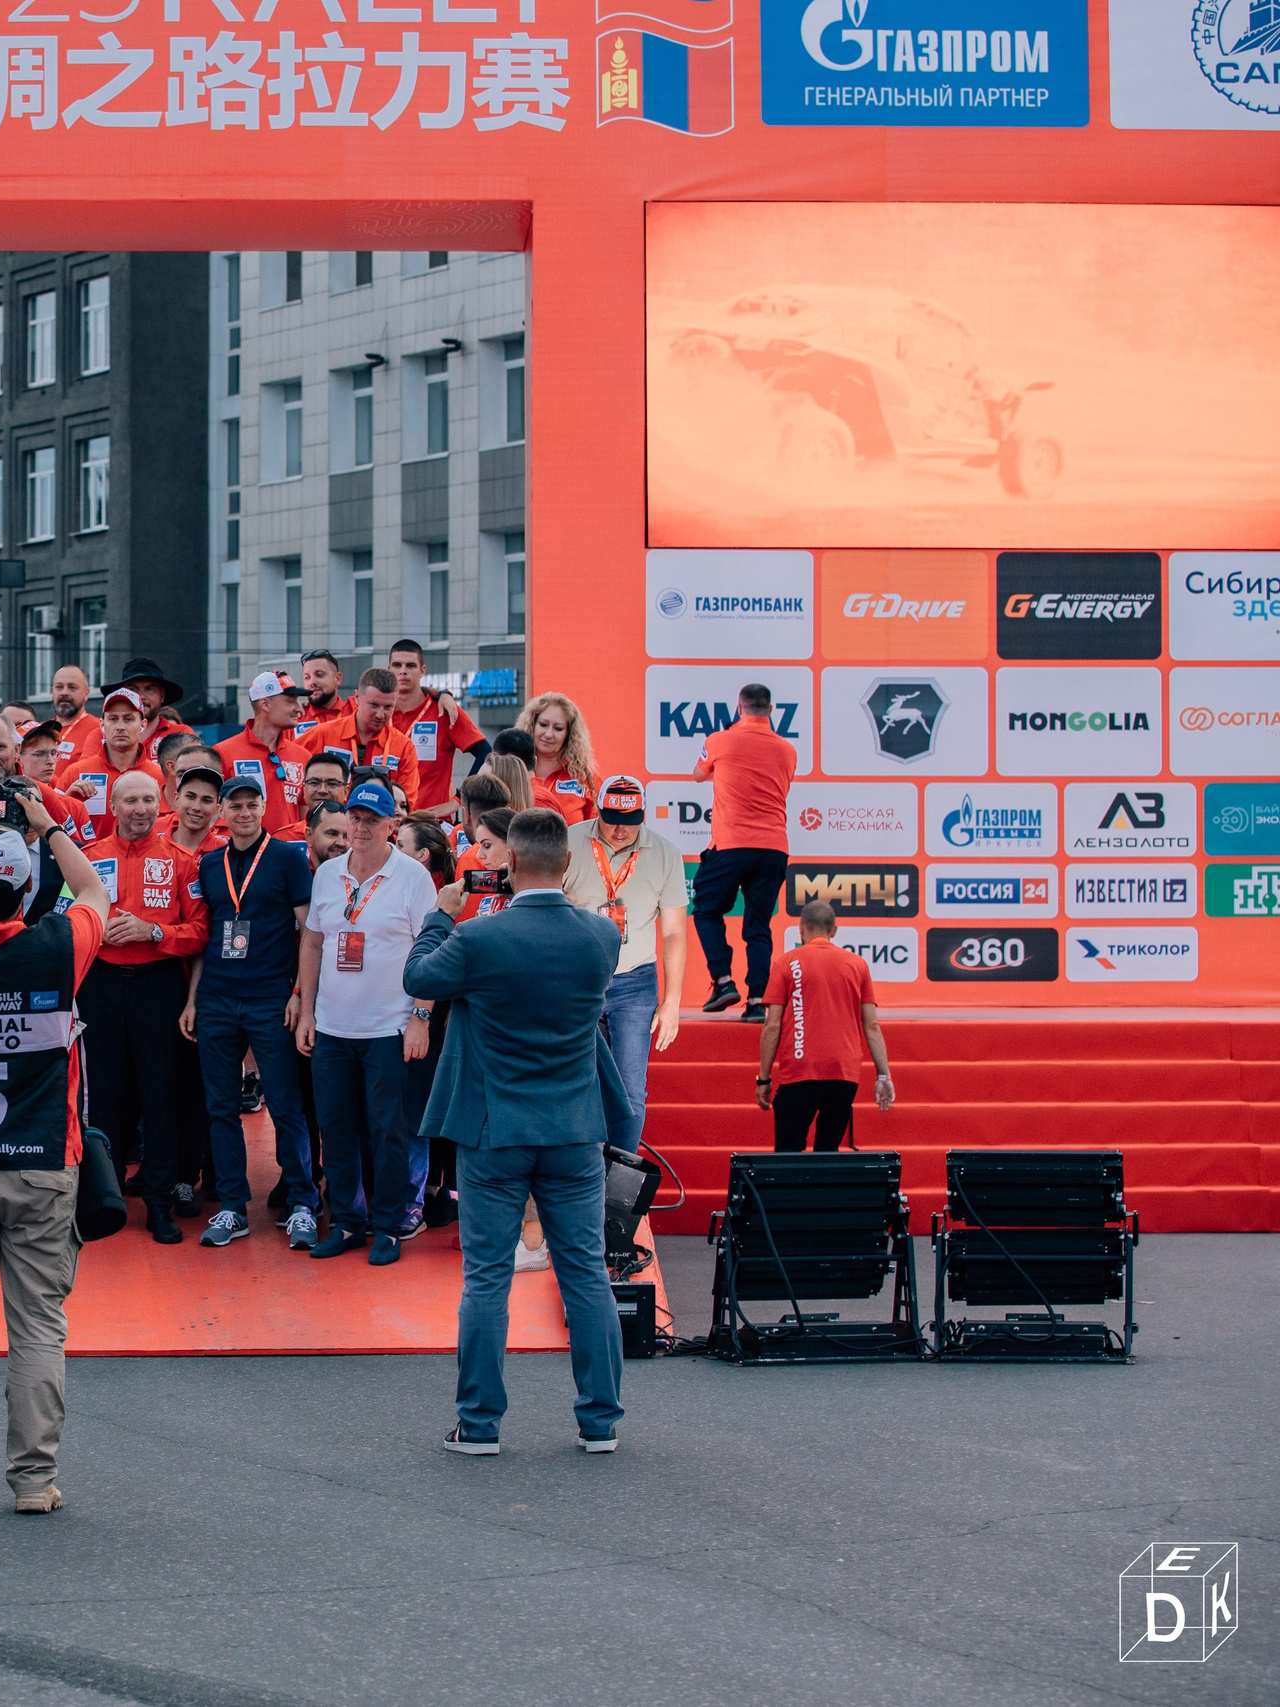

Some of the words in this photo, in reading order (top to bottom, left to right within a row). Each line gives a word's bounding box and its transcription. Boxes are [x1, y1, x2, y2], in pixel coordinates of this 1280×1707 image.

[876, 31, 1049, 74] ГАЗПРОМ
[804, 84, 953, 108] ГЕНЕРАЛЬНЫЙ
[959, 88, 1049, 109] ПАРТНЕР
[1186, 571, 1280, 600] Сибир
[695, 596, 803, 612] ГАЗПРОМБАНК
[1008, 712, 1150, 731] MONGOLIA
[828, 808, 894, 818] РУССКАЯ
[975, 809, 1041, 827] ГАЗПРОМ
[828, 821, 904, 831] МЕХАНИКА
[976, 829, 1041, 838] ДОБЫЧА
[975, 840, 1042, 848] ИРКУТСК
[1073, 837, 1189, 848] ЛЕНЗОЛОТО
[143, 888, 171, 898] SILK
[942, 883, 1014, 899] РОССИЯ
[1024, 883, 1046, 899] 24
[1075, 879, 1157, 903] ИЗВЕСТИЯ
[143, 898, 171, 908] WAY
[961, 938, 1025, 967] 360
[1108, 944, 1190, 955] ТРИКОЛОР
